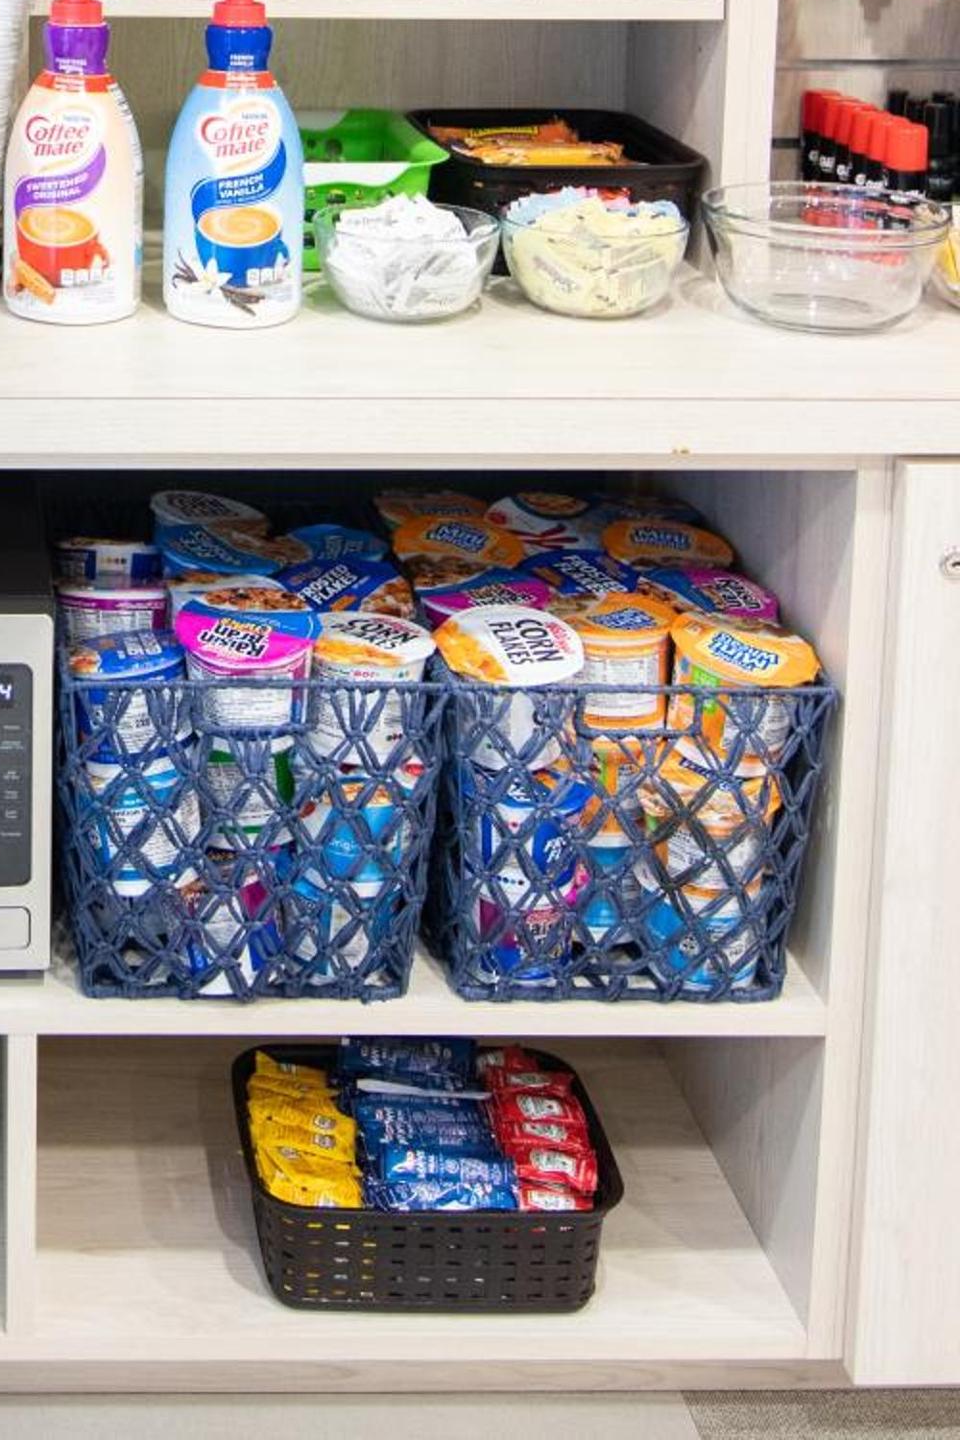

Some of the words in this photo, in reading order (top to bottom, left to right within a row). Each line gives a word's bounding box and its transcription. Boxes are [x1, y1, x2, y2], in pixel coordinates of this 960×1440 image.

[25, 115, 90, 145] Coffee
[200, 116, 270, 145] Coffee
[34, 141, 84, 157] mate
[215, 137, 267, 158] mate
[218, 173, 265, 190] FRENCH
[219, 183, 265, 199] VANILLA
[297, 564, 349, 602] FROSTED
[312, 572, 359, 605] FLAKES
[213, 625, 265, 644] Bran
[348, 618, 419, 644] CORN
[489, 620, 536, 666] FLAKES
[515, 618, 565, 662] CORN
[200, 632, 266, 658] Raisin
